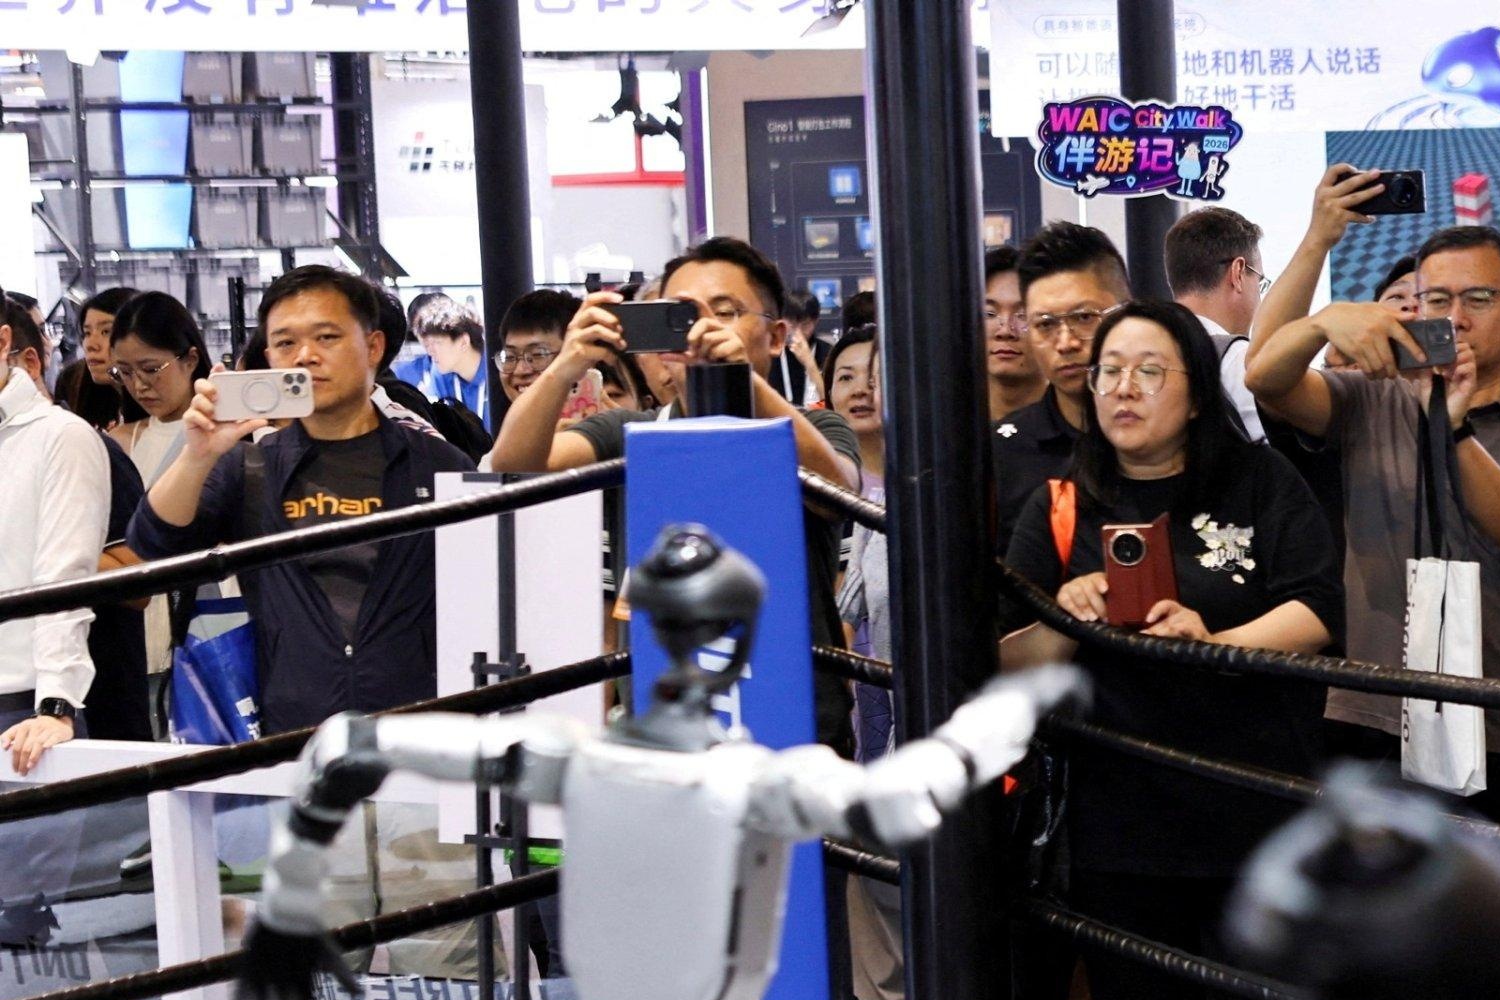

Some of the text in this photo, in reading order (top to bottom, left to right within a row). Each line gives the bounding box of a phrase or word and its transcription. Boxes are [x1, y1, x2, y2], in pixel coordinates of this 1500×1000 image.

[1036, 47, 1381, 79] 可以随地和机器人说话
[1050, 107, 1227, 133] WAIC City Walk
[1054, 136, 1174, 173] 伴游记
[1204, 138, 1228, 149] 2026
[284, 492, 382, 518] arhar
